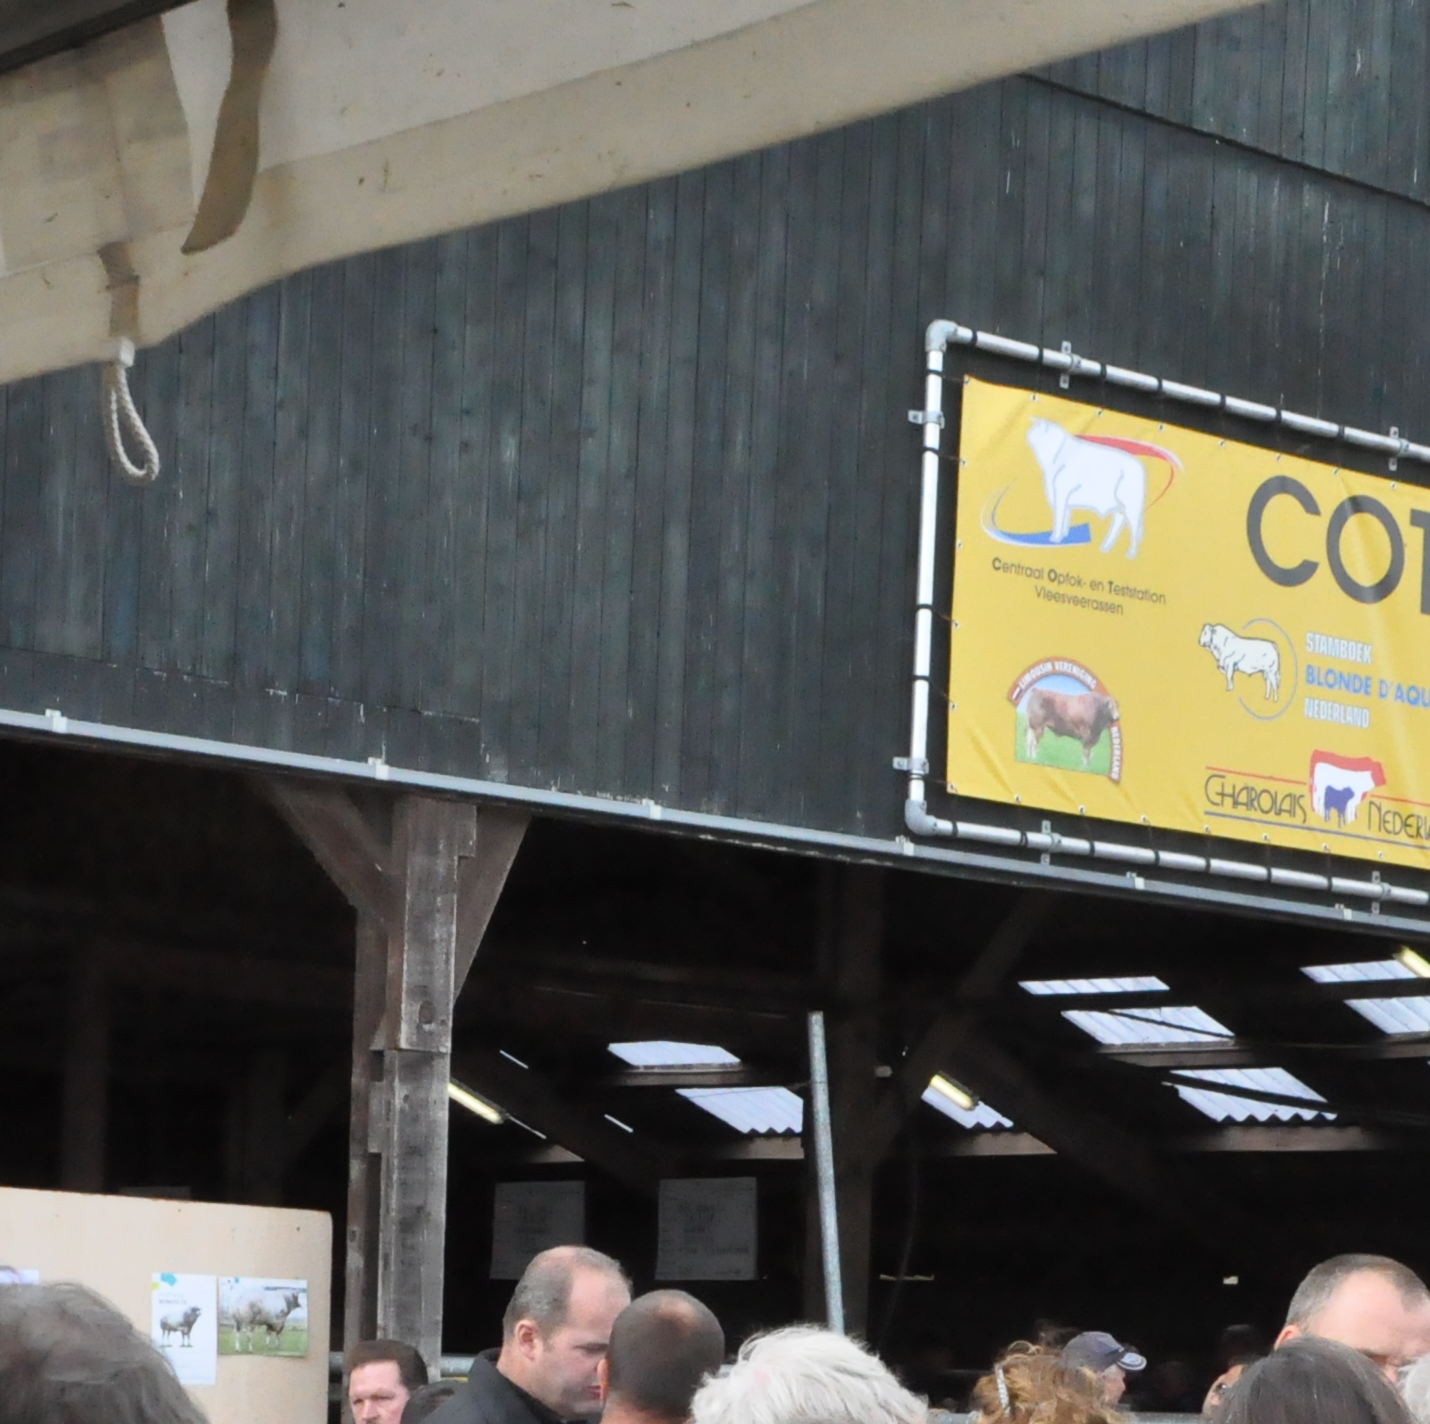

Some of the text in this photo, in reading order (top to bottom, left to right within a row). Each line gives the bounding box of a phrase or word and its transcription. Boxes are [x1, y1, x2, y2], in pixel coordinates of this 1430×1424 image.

[991, 556, 1044, 580] Centraal
[1089, 579, 1105, 593] en
[1107, 580, 1167, 605] Teststation
[1034, 584, 1125, 616] Vleesveerassen
[1305, 631, 1373, 665] STAMBOEK
[1305, 663, 1372, 697] BLONDE
[1303, 696, 1371, 730] NEDERLAND
[1204, 773, 1308, 825] CHAROLAIS
